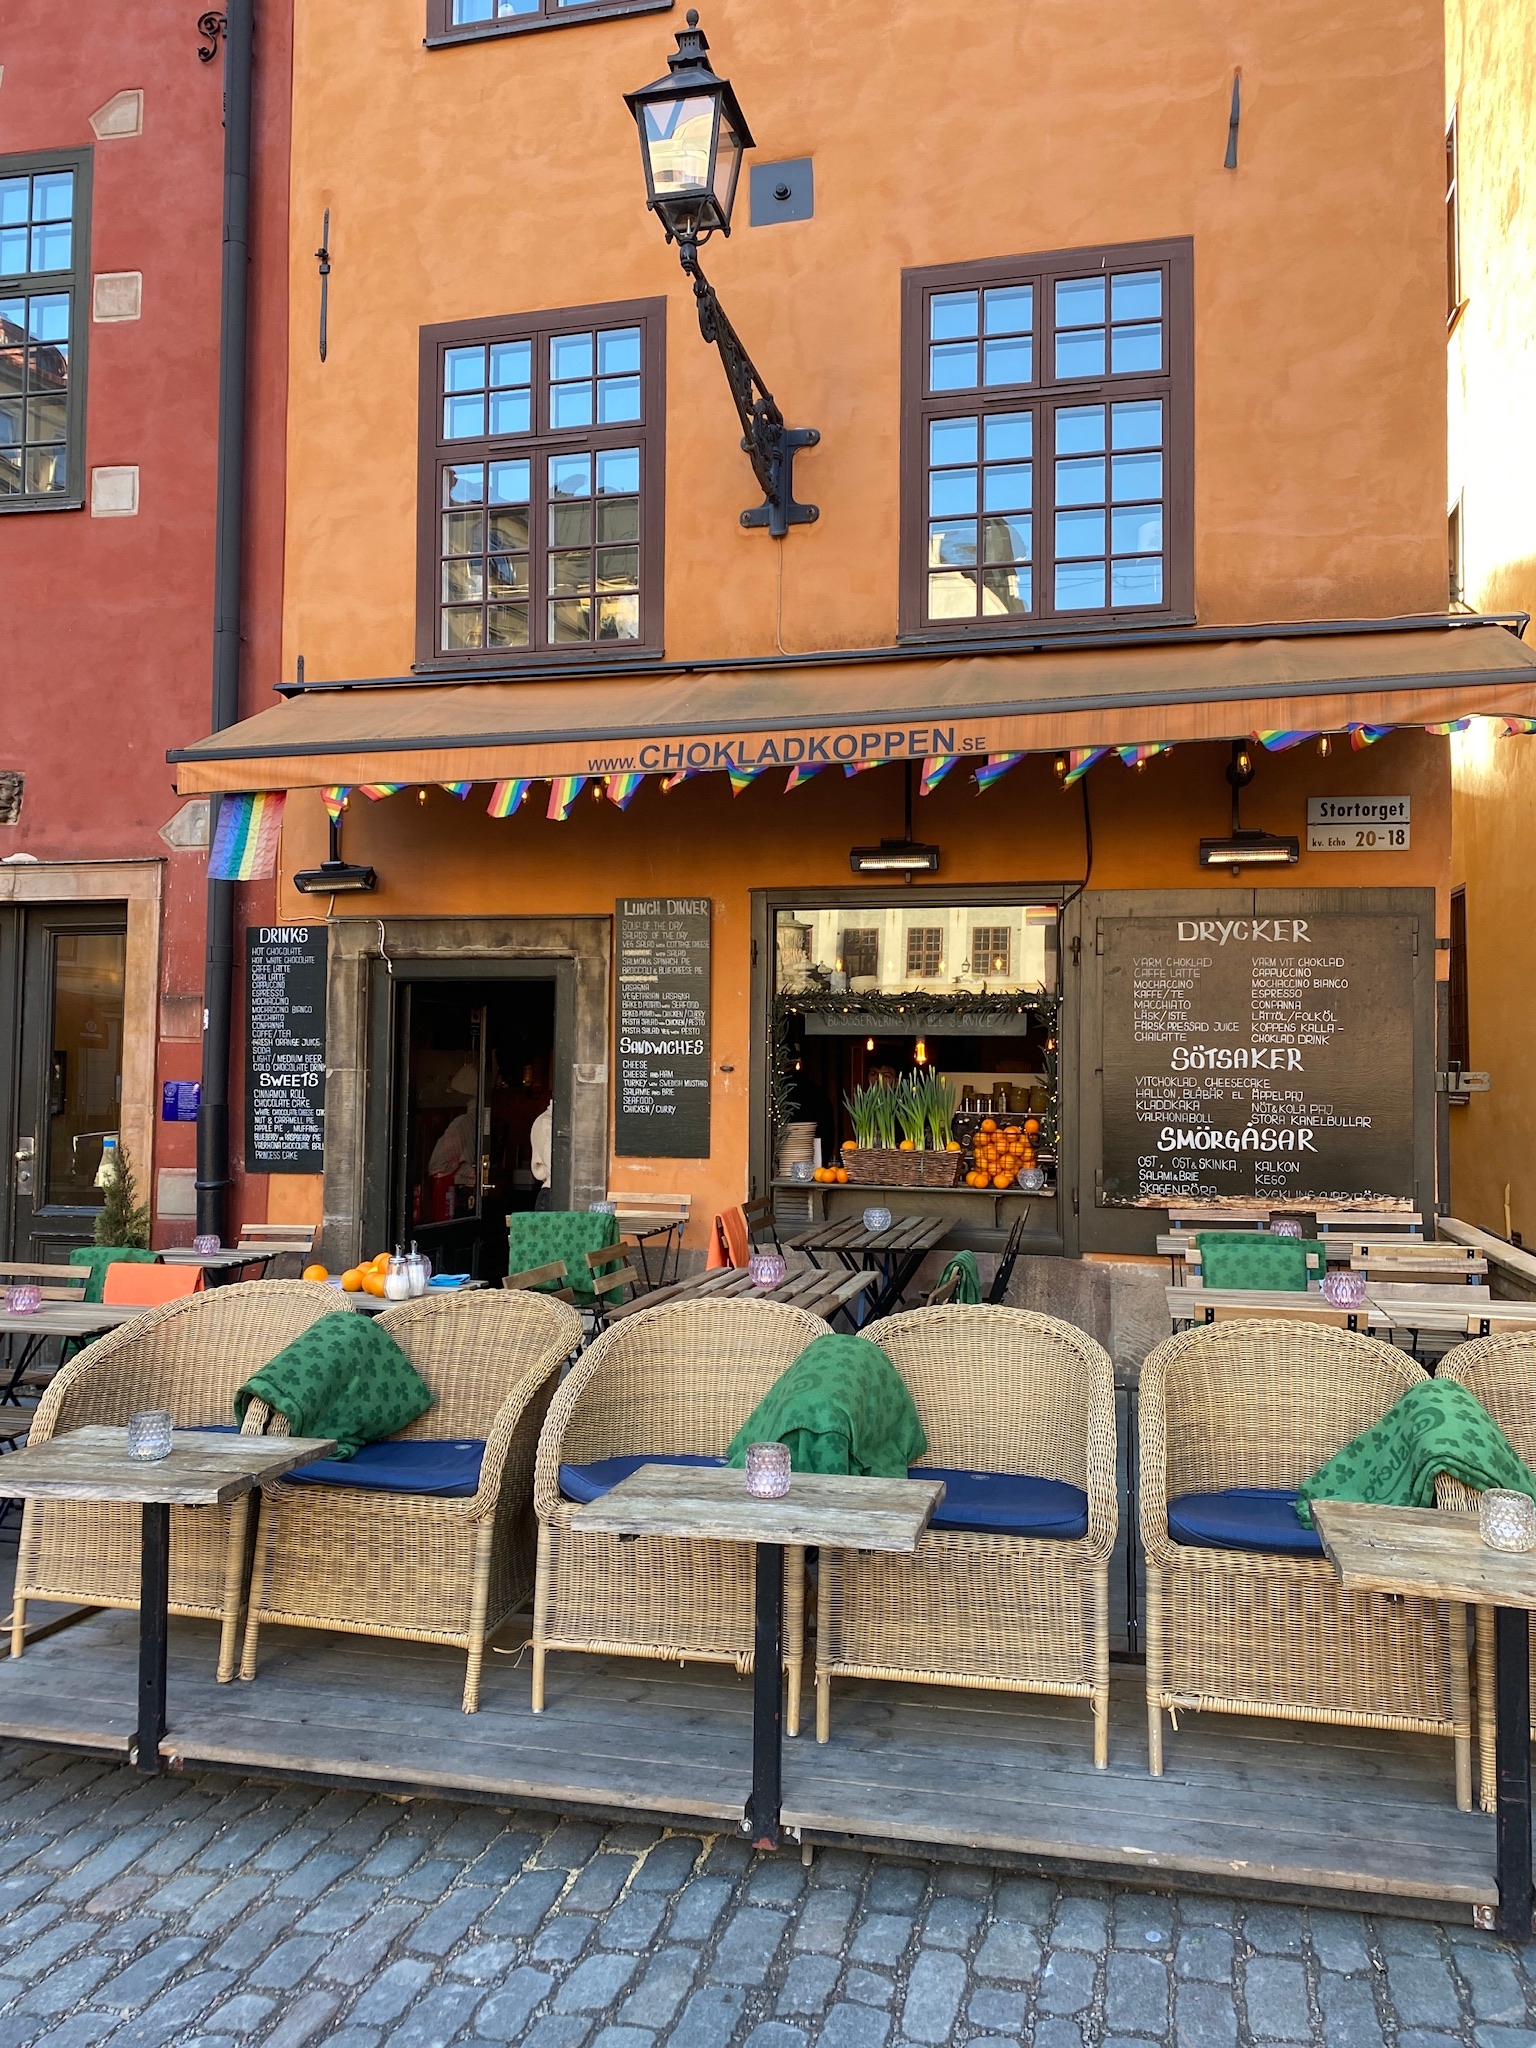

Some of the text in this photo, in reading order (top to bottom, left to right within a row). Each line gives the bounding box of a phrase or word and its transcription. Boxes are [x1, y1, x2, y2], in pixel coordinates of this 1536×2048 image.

[1320, 802, 1405, 820] Stortorget
[1312, 838, 1324, 847] kv.
[1328, 837, 1346, 847] Echo
[624, 899, 709, 916] LUNCH DINNER
[643, 921, 650, 930] OF
[654, 921, 666, 930] THE
[669, 921, 684, 931] DAY
[260, 927, 309, 944] DRINKS
[652, 931, 660, 939] OF
[662, 931, 674, 940] THE
[676, 931, 689, 940] DAY
[1177, 919, 1312, 946] DRYCKER
[636, 940, 655, 948] SALAD
[667, 940, 691, 948] COTTAGE
[252, 946, 303, 956] HOT CHOCOLATE
[667, 949, 687, 957] SALAD
[252, 956, 264, 964] HOT
[283, 955, 316, 964] CHOCOLATE
[653, 957, 691, 966] SPINACH PIE
[1133, 957, 1213, 968] VARM CHOKLAD
[1252, 957, 1345, 968] VARM VIT CHOKLAD
[273, 964, 291, 973] LATTE
[622, 966, 652, 974] BROCCOLI
[695, 966, 703, 975] PIE
[1133, 968, 1201, 978] CAFFE LATTE
[1252, 967, 1312, 978] CAPPUCCINO
[268, 972, 286, 981] LATTE
[622, 983, 650, 992] LASAGNA
[1133, 980, 1194, 989] MOCHACCINO
[1252, 979, 1349, 989] MOCHACCINO BIANCO
[252, 989, 285, 997] ESPRESSO
[622, 992, 691, 1001] VEGETARIAN LASAGNA
[1251, 989, 1303, 999] ESPRESSO
[622, 1000, 643, 1009] BAKED
[671, 1001, 700, 1009] SEAFOOD
[1133, 1000, 1192, 1010] MACCHIATO
[1251, 999, 1302, 1010] CONPANNA
[622, 1009, 639, 1018] BAKED
[622, 1018, 640, 1026] PASTA
[641, 1018, 659, 1026] SALAD
[1213, 1021, 1240, 1032] JUICE
[622, 1026, 641, 1035] PASTA
[641, 1026, 660, 1035] SALAD
[681, 1027, 701, 1035] PESTO
[1251, 1022, 1335, 1034] KOPPENS KALLA
[275, 1038, 300, 1046] ORANGE
[301, 1038, 321, 1047] JUICE
[1251, 1033, 1331, 1046] CHOKLAD DRINK
[252, 1046, 272, 1055] SODA
[620, 1036, 704, 1055] SANDWICHES
[305, 1054, 323, 1063] BEER
[1170, 1044, 1305, 1072] SÖTSAKER
[252, 1063, 271, 1072] COLD
[272, 1063, 309, 1072] CHOCOLATE
[622, 1059, 648, 1069] CHEESE
[622, 1069, 648, 1079] CHEESE
[659, 1070, 674, 1078] HAM
[260, 1072, 319, 1087] SWEETS
[622, 1078, 648, 1088] TURKEY
[659, 1079, 683, 1087] SWEDISH
[1204, 1076, 1271, 1089] CHEESECAKE
[253, 1088, 306, 1099] CINNAMON ROLL
[661, 1087, 675, 1096] BRIE
[1231, 1091, 1245, 1100] EL
[1251, 1088, 1304, 1103] ÄPPELPAJ
[253, 1099, 311, 1108] CHOCOLATE CAKE
[623, 1096, 654, 1105] SEAFOOD
[1135, 1100, 1201, 1111] KLADDKAKA
[1309, 1103, 1334, 1116] PAJ
[254, 1116, 266, 1124] NUT
[267, 1116, 273, 1124] &
[1136, 1111, 1214, 1124] VALRHONABOLL
[1251, 1113, 1372, 1129] STORA KANELBULLAR
[254, 1124, 272, 1133] APPLE
[293, 1124, 319, 1133] MUFFINS
[312, 1132, 322, 1141] PIE
[1156, 1122, 1320, 1153] SMÖRGÅSAR
[255, 1150, 299, 1160] PRINCESS CAKE
[1254, 1160, 1301, 1174] KALKON
[1254, 1173, 1287, 1186] KESO
